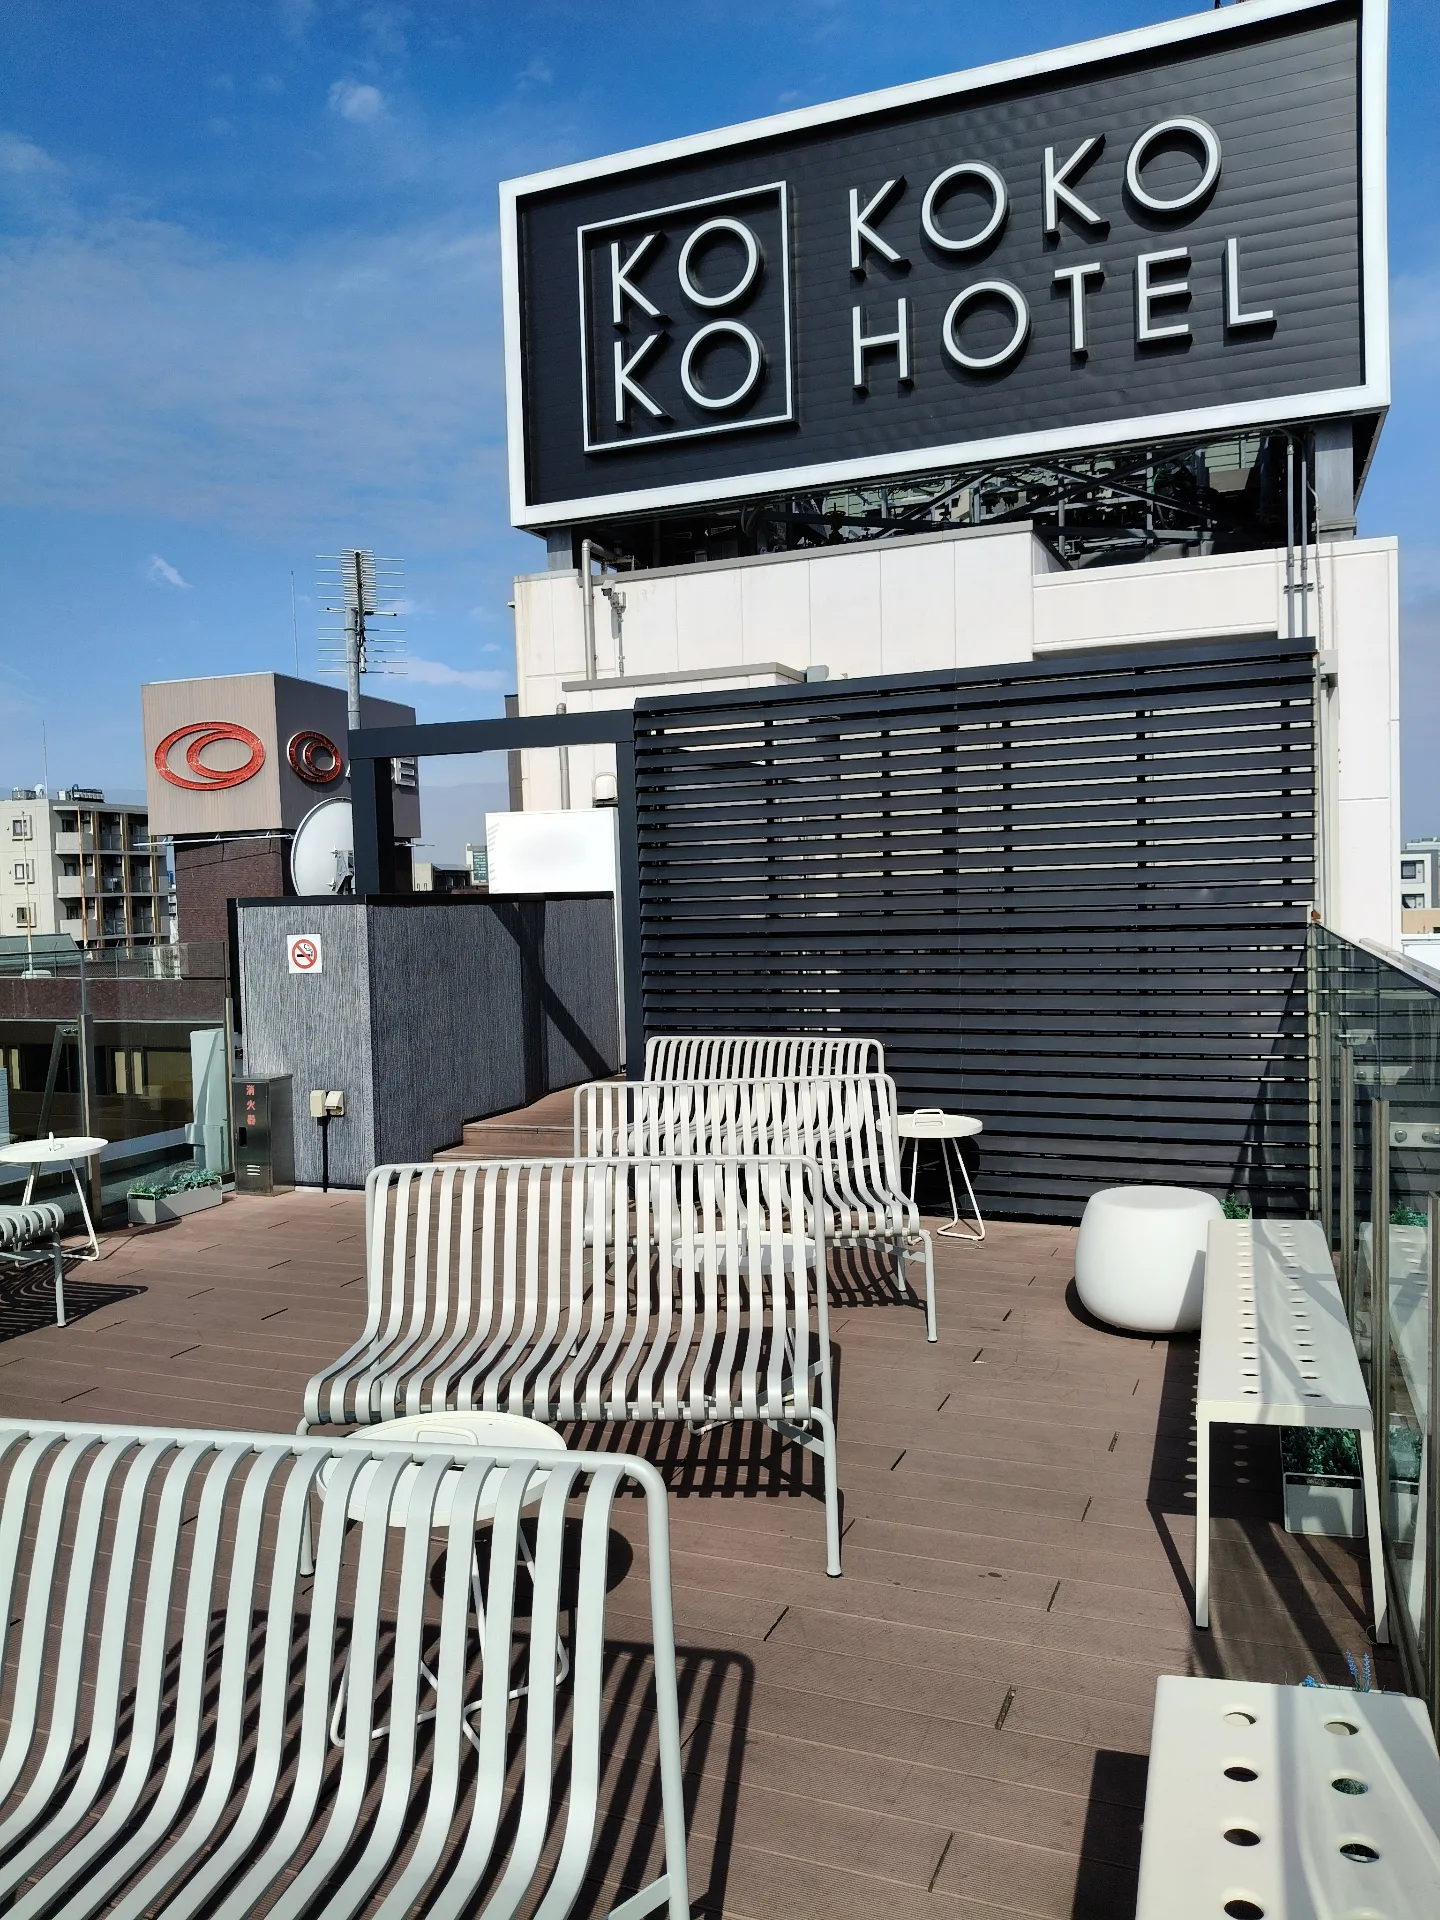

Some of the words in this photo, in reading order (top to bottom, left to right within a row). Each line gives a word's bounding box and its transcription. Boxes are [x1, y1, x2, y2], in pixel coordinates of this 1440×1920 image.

[849, 116, 1222, 271] KOKO
[609, 216, 761, 325] KO
[852, 237, 1275, 388] HOTEL
[612, 319, 763, 424] KO
[246, 1084, 256, 1126] 消火器
